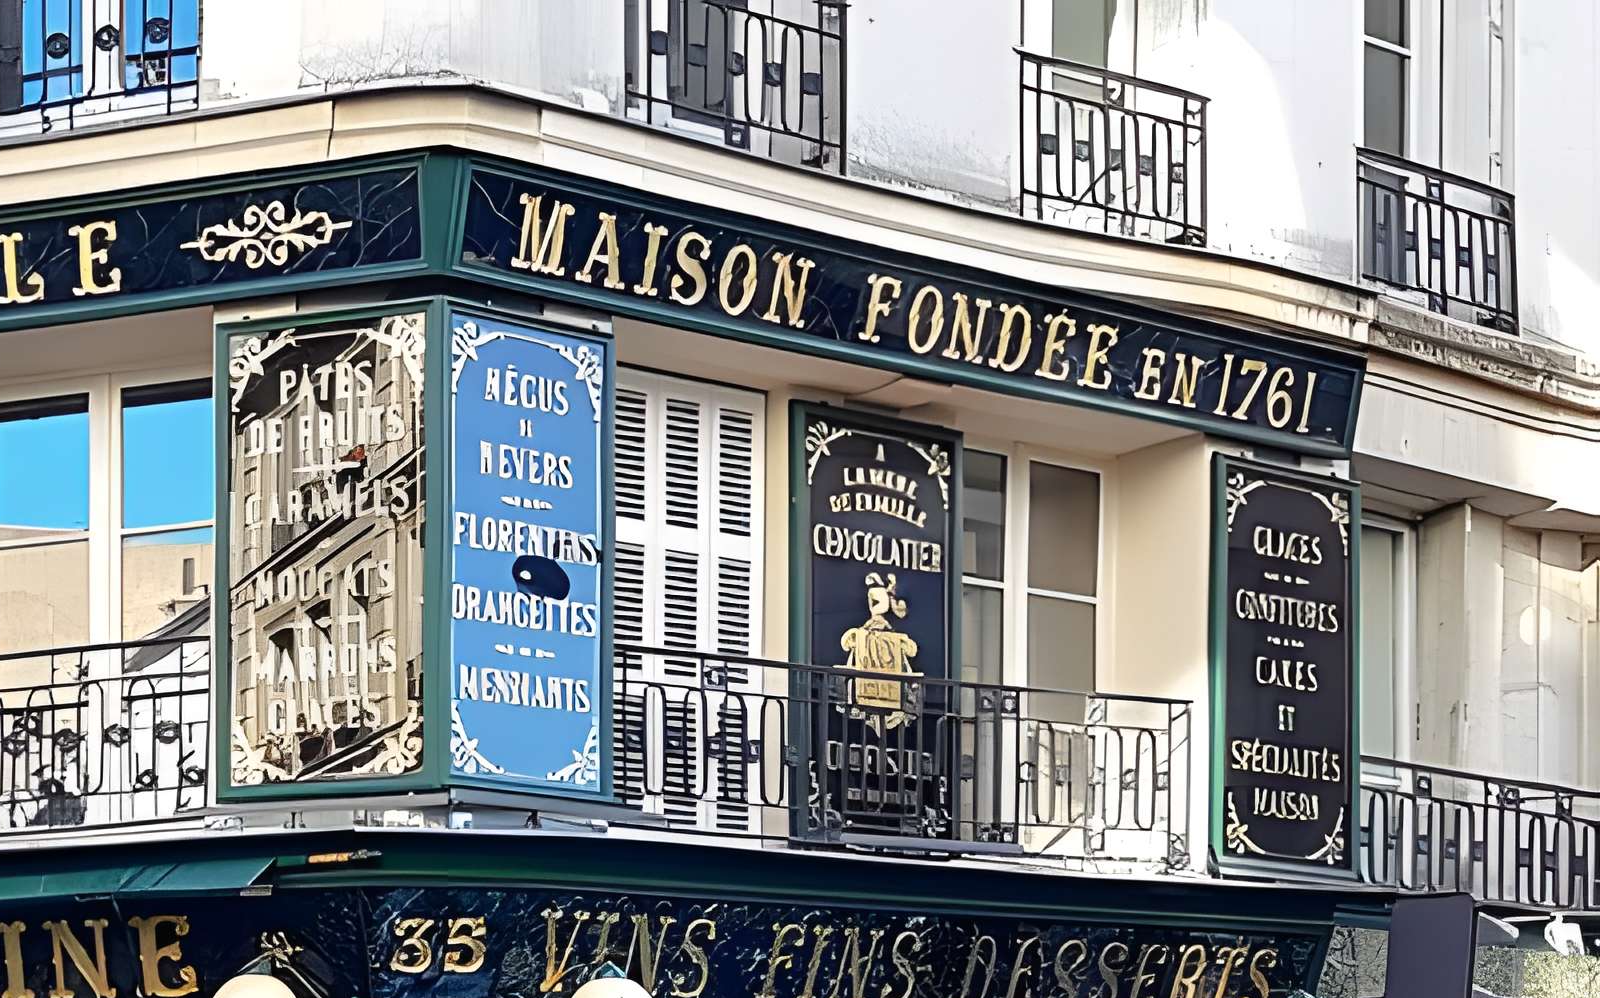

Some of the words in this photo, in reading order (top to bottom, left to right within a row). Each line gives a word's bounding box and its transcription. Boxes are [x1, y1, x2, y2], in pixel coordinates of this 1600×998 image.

[511, 191, 815, 328] MAISON
[1133, 346, 1206, 409] EN
[1212, 353, 1318, 434] 1761
[392, 917, 486, 973] 35
